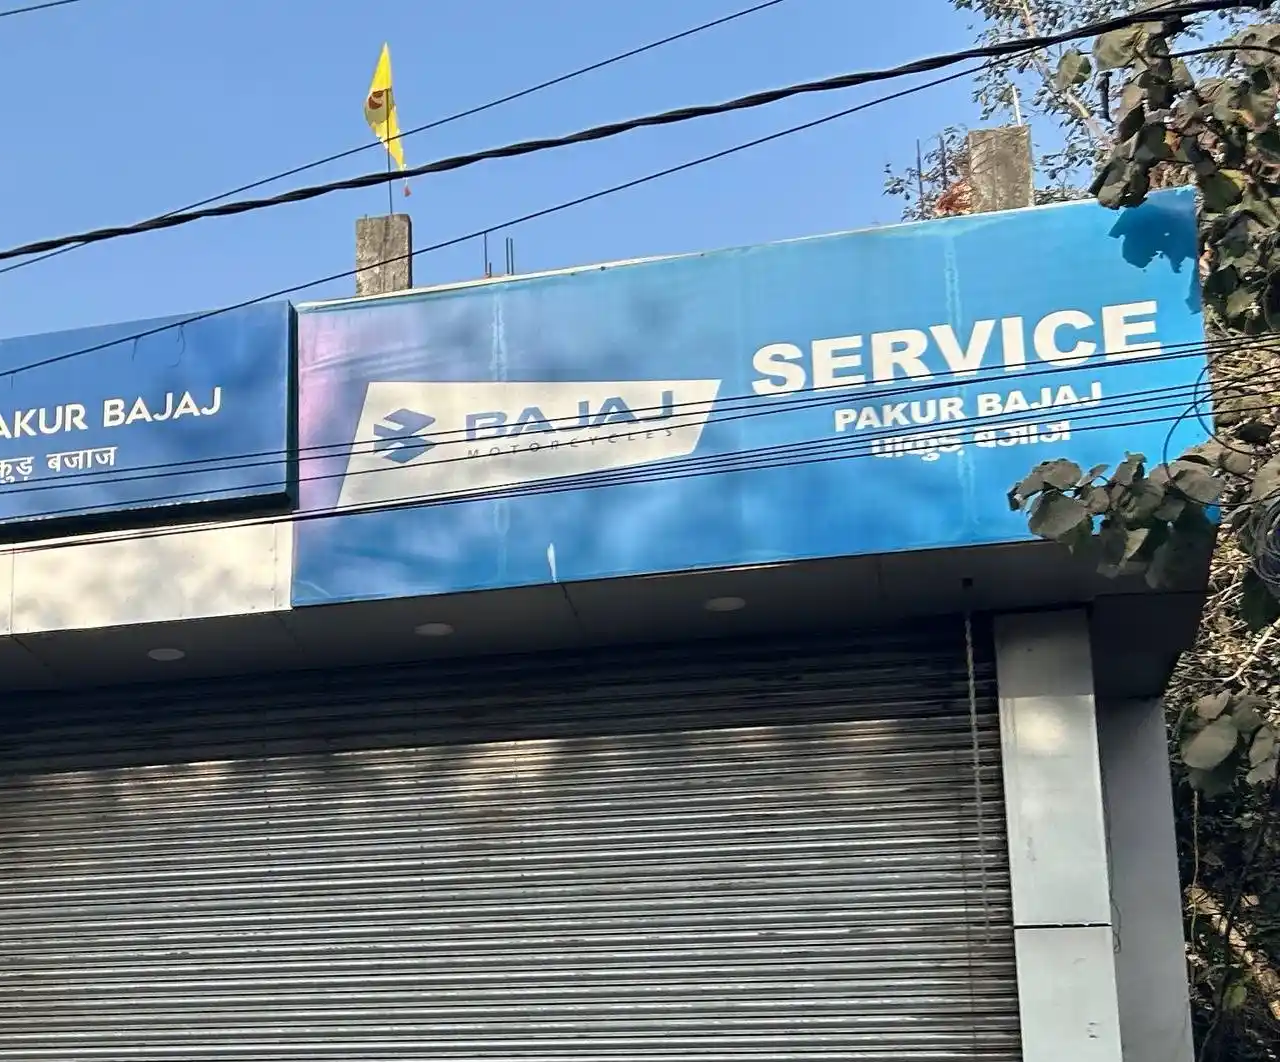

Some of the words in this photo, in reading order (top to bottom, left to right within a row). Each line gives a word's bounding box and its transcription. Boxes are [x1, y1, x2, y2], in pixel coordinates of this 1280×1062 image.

[752, 300, 1162, 398] SERVICE
[103, 387, 222, 427] BAJAJ
[465, 390, 674, 441] BAJAJ
[835, 396, 974, 432] PAKUR
[977, 382, 1103, 418] BAJAJ
[46, 446, 118, 472] बजाज
